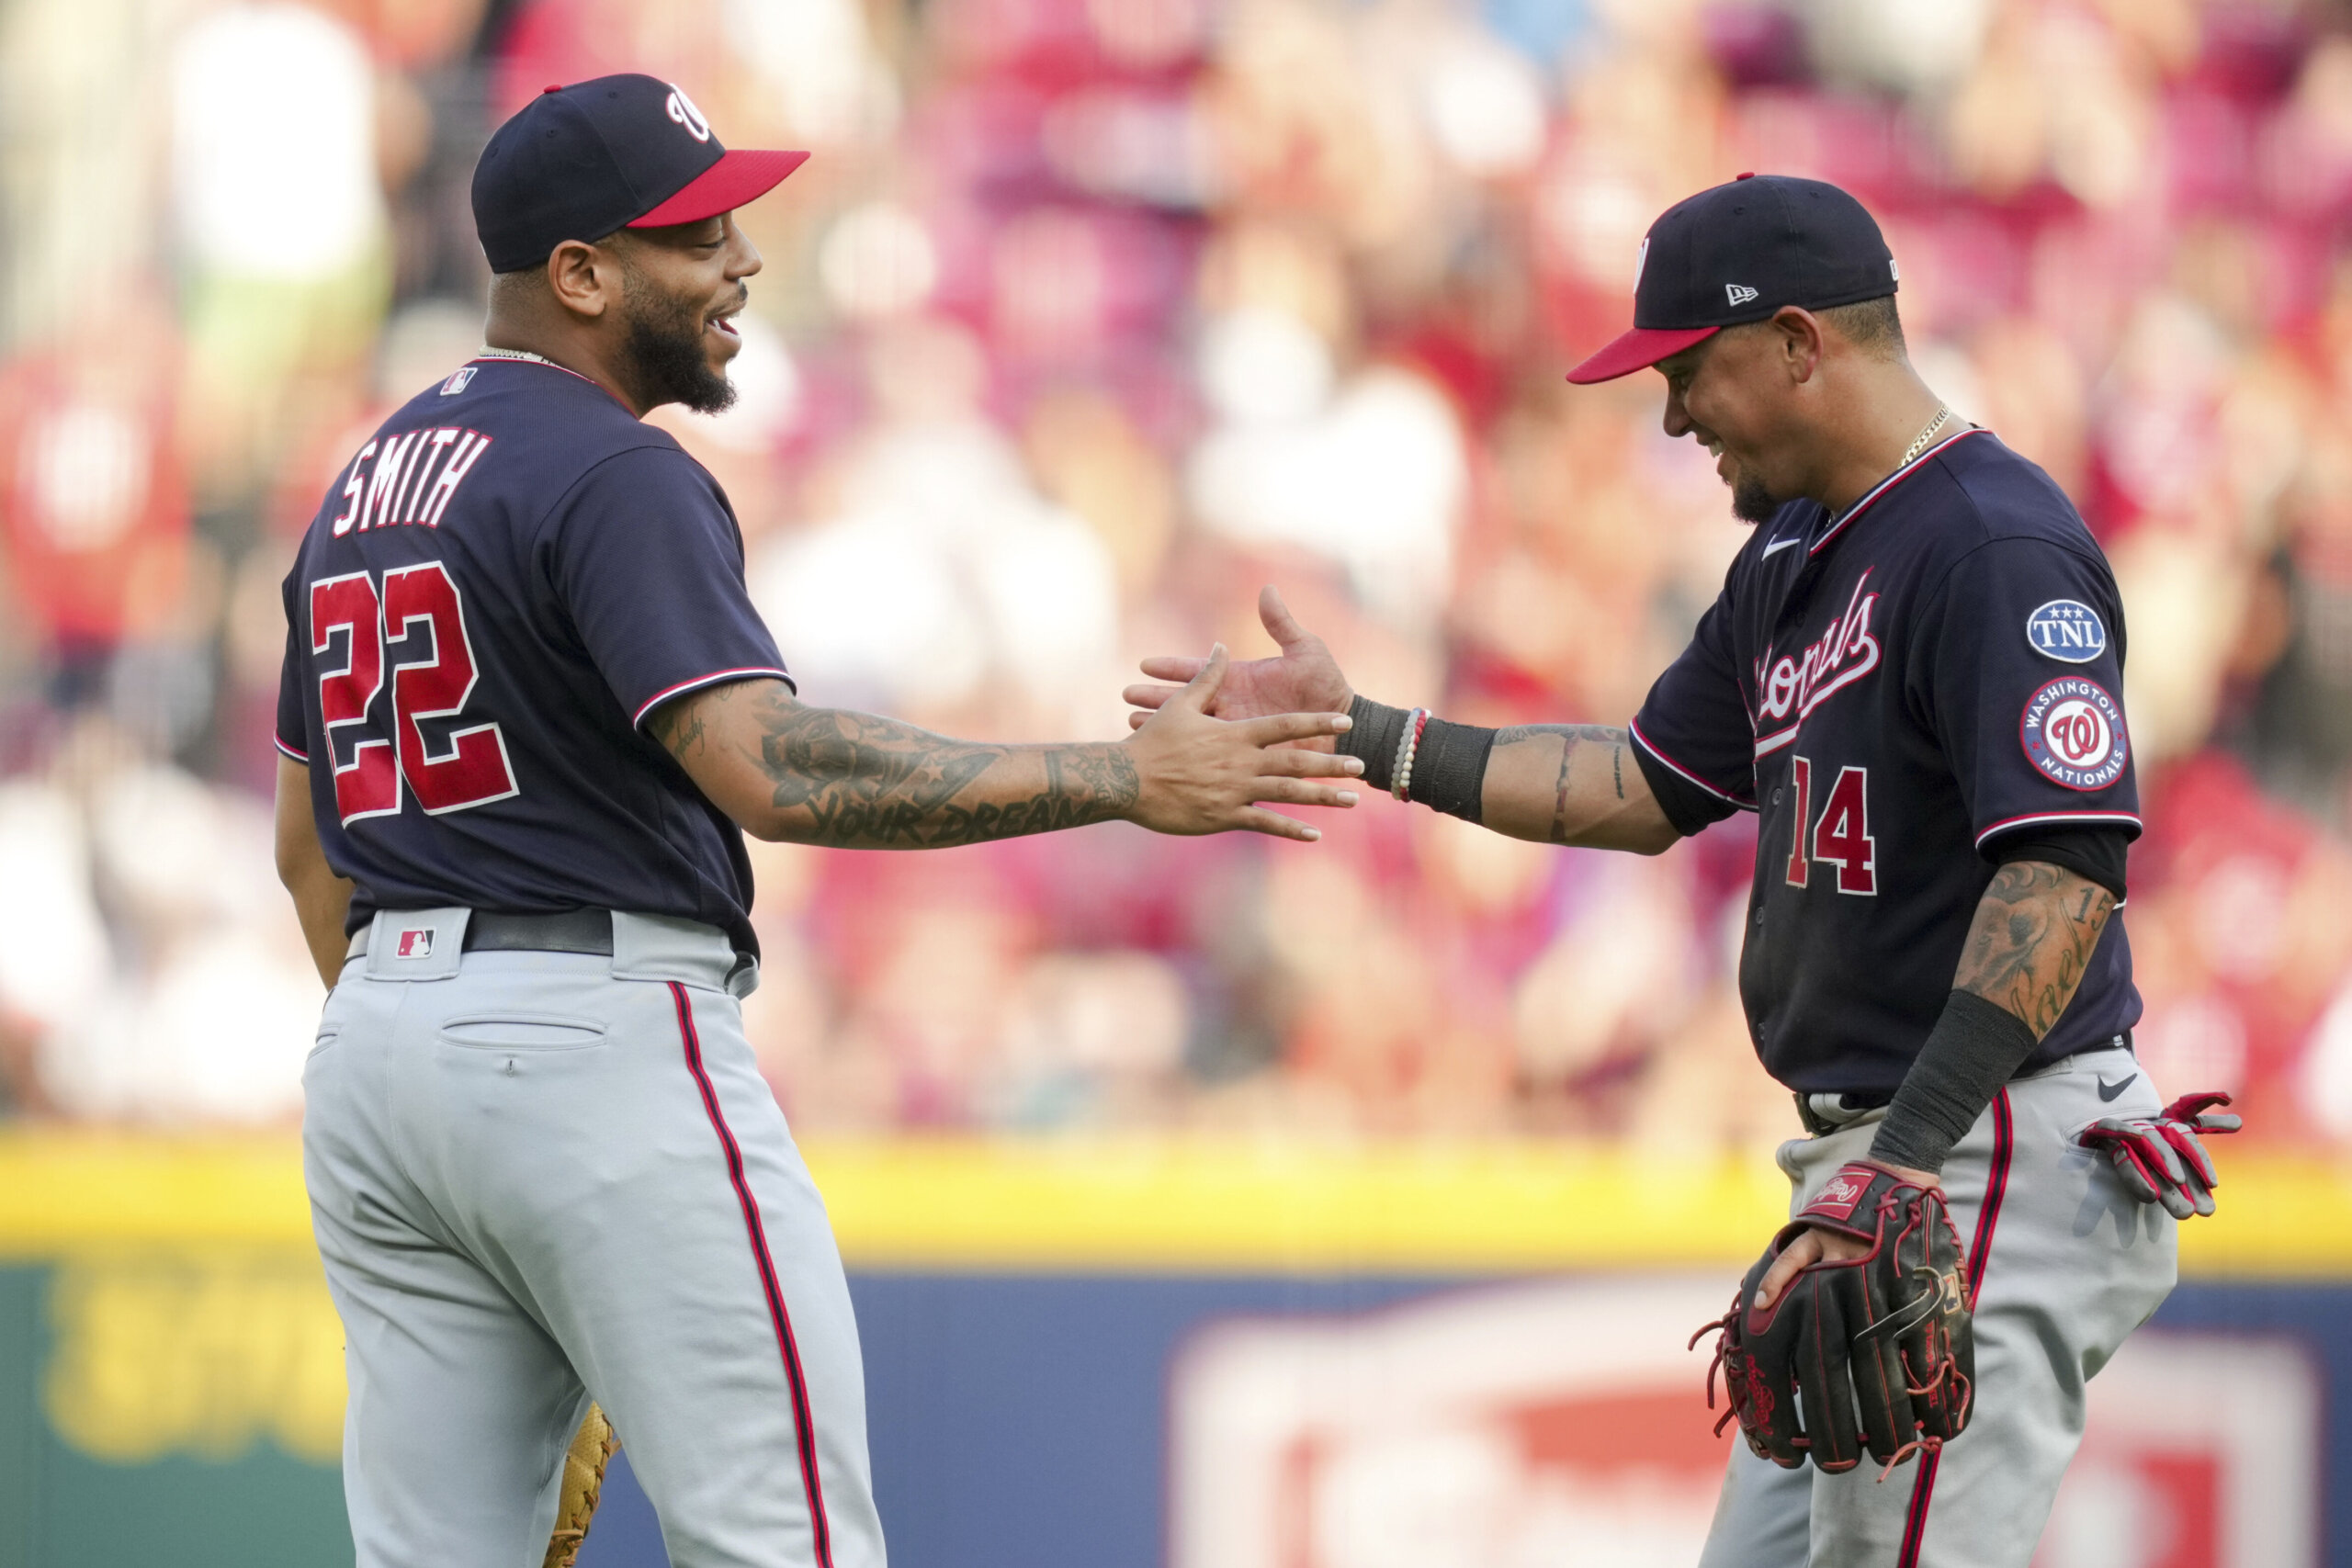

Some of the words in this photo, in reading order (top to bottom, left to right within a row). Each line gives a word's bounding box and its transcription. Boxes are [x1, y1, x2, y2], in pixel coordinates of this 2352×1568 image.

[334, 426, 493, 539] SMITH
[2033, 620, 2102, 649] TNL
[311, 560, 520, 829] 22
[2026, 682, 2118, 728] WASHINGTON
[2041, 749, 2124, 785] NATIONALS
[807, 792, 924, 845] YOUR
[928, 794, 1094, 843] DREAM
[1786, 754, 1877, 897] 14
[2073, 886, 2113, 931] 15
